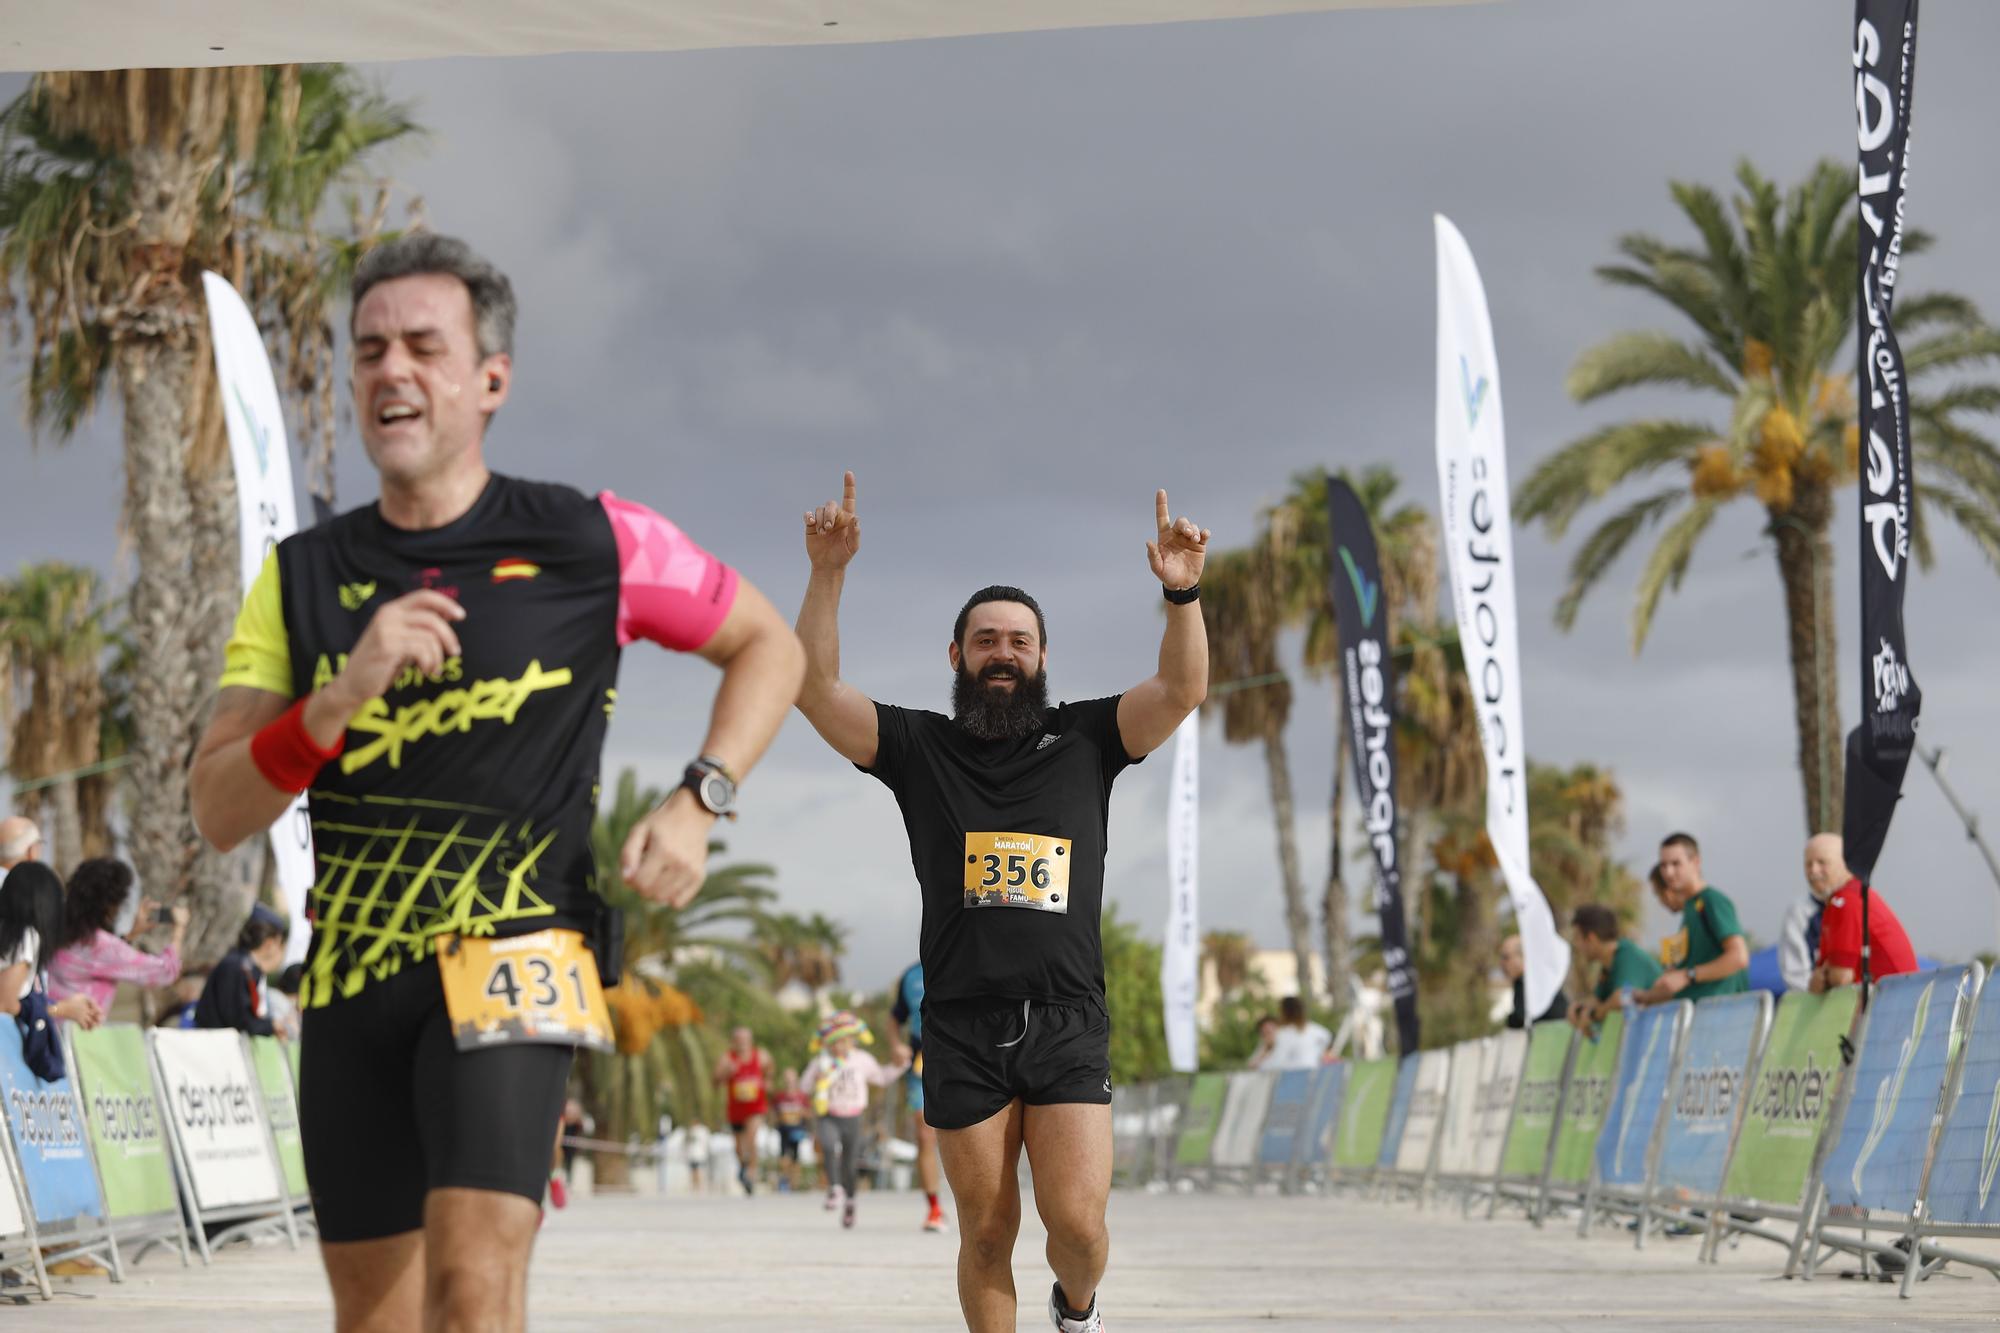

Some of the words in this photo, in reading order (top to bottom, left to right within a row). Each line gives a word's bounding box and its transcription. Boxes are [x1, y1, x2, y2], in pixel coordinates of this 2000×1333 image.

[994, 841, 1031, 851] MARATÓN
[982, 854, 1051, 890] 356
[486, 957, 588, 1013] 431
